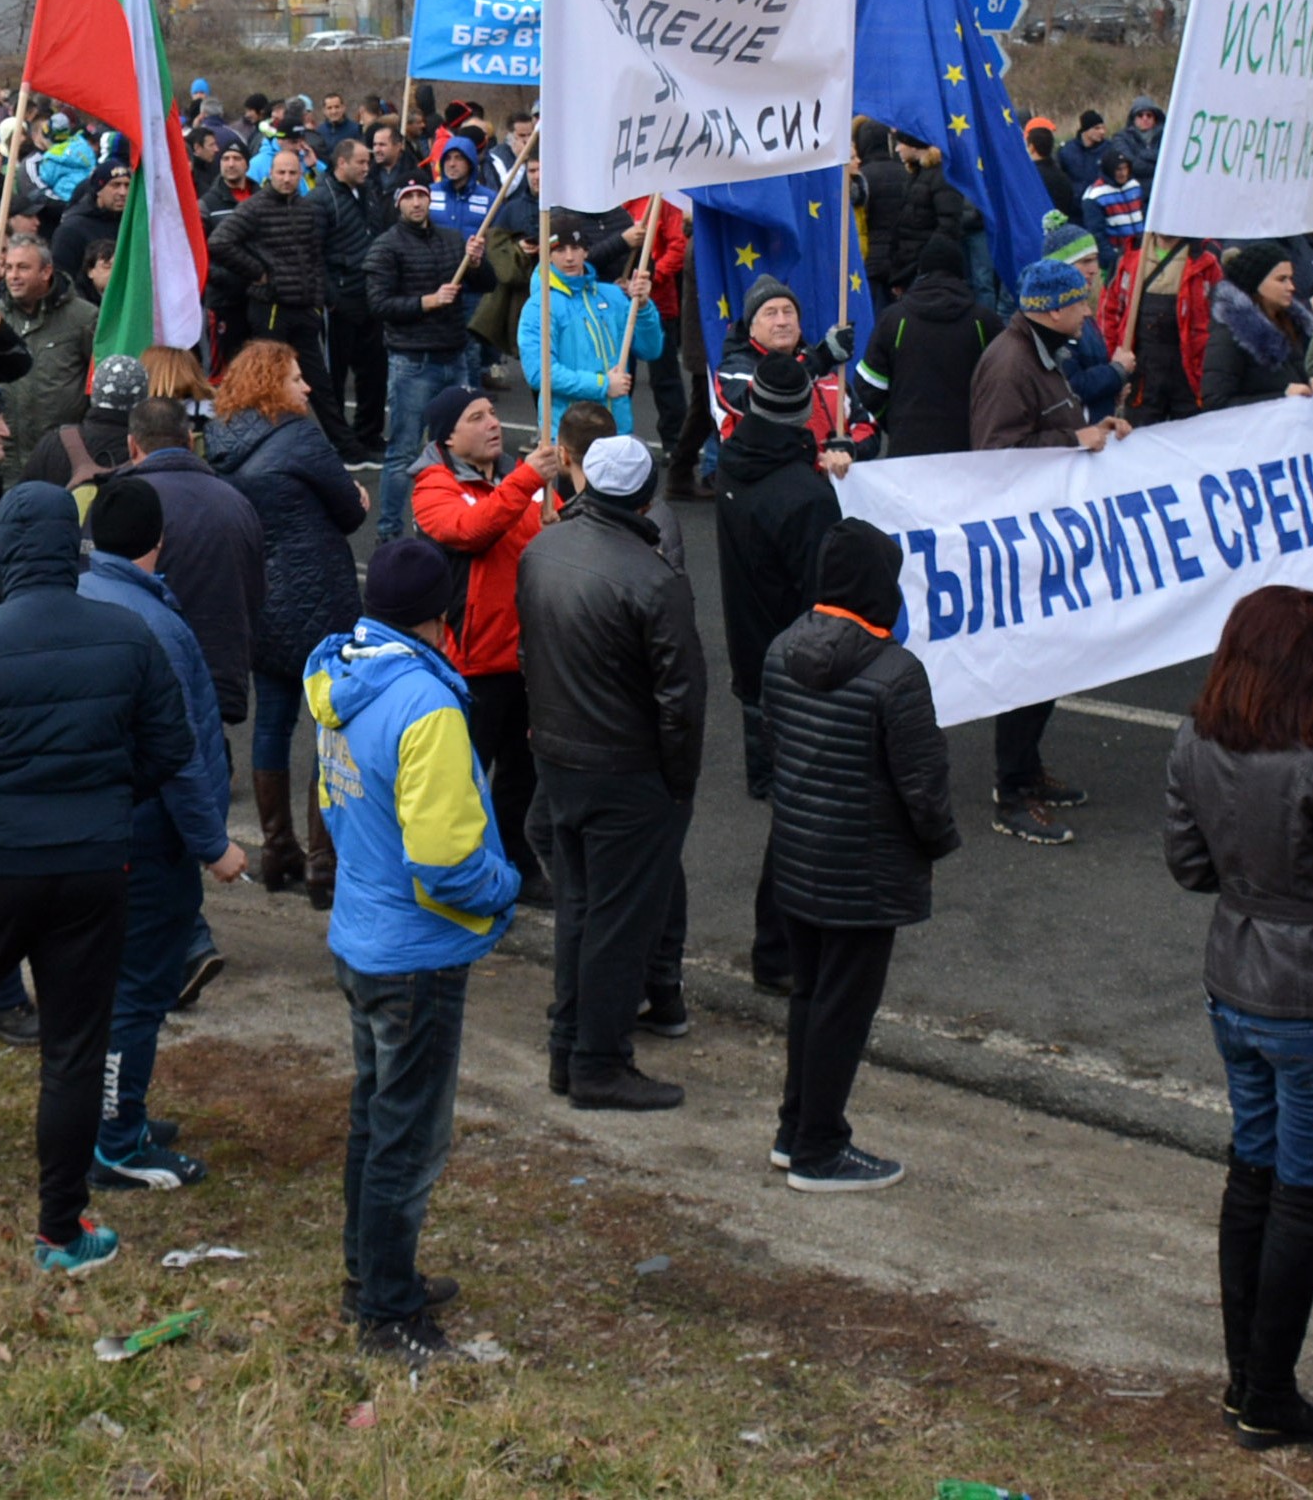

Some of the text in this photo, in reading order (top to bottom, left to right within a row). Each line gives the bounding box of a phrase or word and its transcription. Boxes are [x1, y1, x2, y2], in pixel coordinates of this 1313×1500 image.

[451, 24, 509, 47] БЕЗ
[461, 53, 542, 78] КАБИ
[612, 99, 822, 188] ДЕЦАТА СИ!
[1181, 110, 1293, 184] ВТОРАТА
